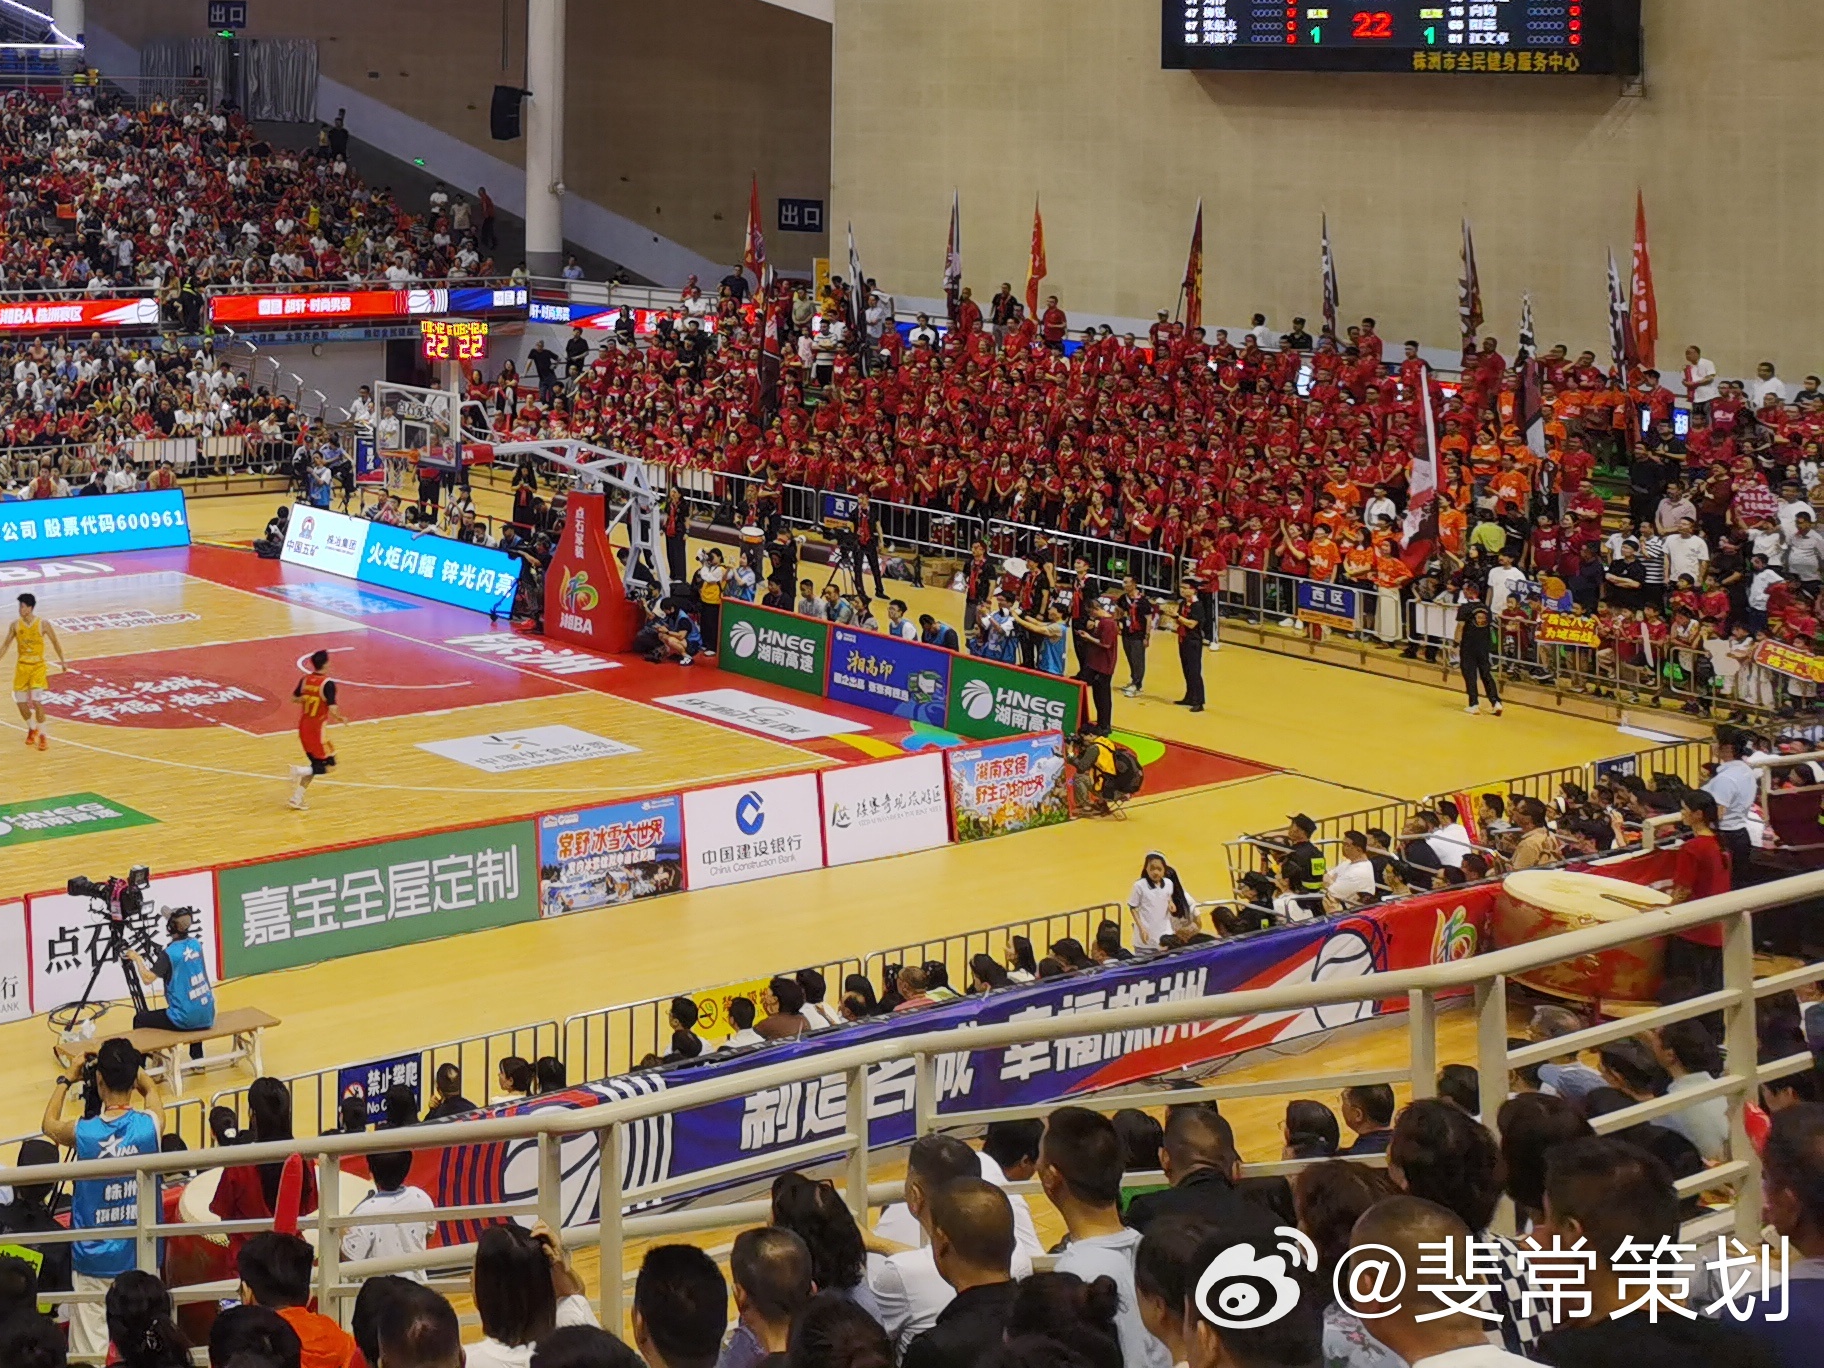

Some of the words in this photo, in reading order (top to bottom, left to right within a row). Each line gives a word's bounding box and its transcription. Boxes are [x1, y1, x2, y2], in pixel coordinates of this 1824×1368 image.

[211, 4, 243, 23] 出口
[1352, 11, 1393, 39] 22
[1310, 26, 1322, 44] 1
[1423, 27, 1436, 45] 1
[1412, 51, 1581, 72] 株洲市全民健身服务中心
[781, 204, 820, 226] 出口
[0, 306, 33, 325] 湘BA
[284, 296, 351, 313] 胡轩·时尚男装
[426, 334, 449, 359] 22
[458, 334, 484, 358] 22
[44, 510, 185, 539] 股票代码600961
[574, 506, 584, 560] 点石家装
[286, 538, 319, 557] 中国五矿
[326, 533, 357, 551] 株冶集团
[367, 542, 438, 579] 火炬闪耀
[441, 559, 516, 599] 锌光闪亮
[1311, 586, 1344, 605] 西区
[560, 612, 593, 635] 湘BA
[759, 628, 816, 652] HNEG
[757, 643, 814, 673] 湖南高速
[846, 650, 894, 681] 湘高印
[996, 687, 1067, 717] HNEG
[994, 704, 1063, 732] 湖南高速
[976, 755, 1028, 780] 湖南常德
[976, 774, 1045, 804] 野生动物世界
[4, 798, 108, 823] HNEG
[557, 816, 665, 861] 常野冰雪大世界
[702, 834, 803, 865] 中国建设银行
[709, 863, 732, 876] China
[733, 856, 777, 873] Construction
[778, 853, 797, 866] Bank
[240, 842, 520, 950] 嘉宝全屋定制
[367, 1062, 417, 1097] 禁止攀爬
[367, 1102, 380, 1114] No
